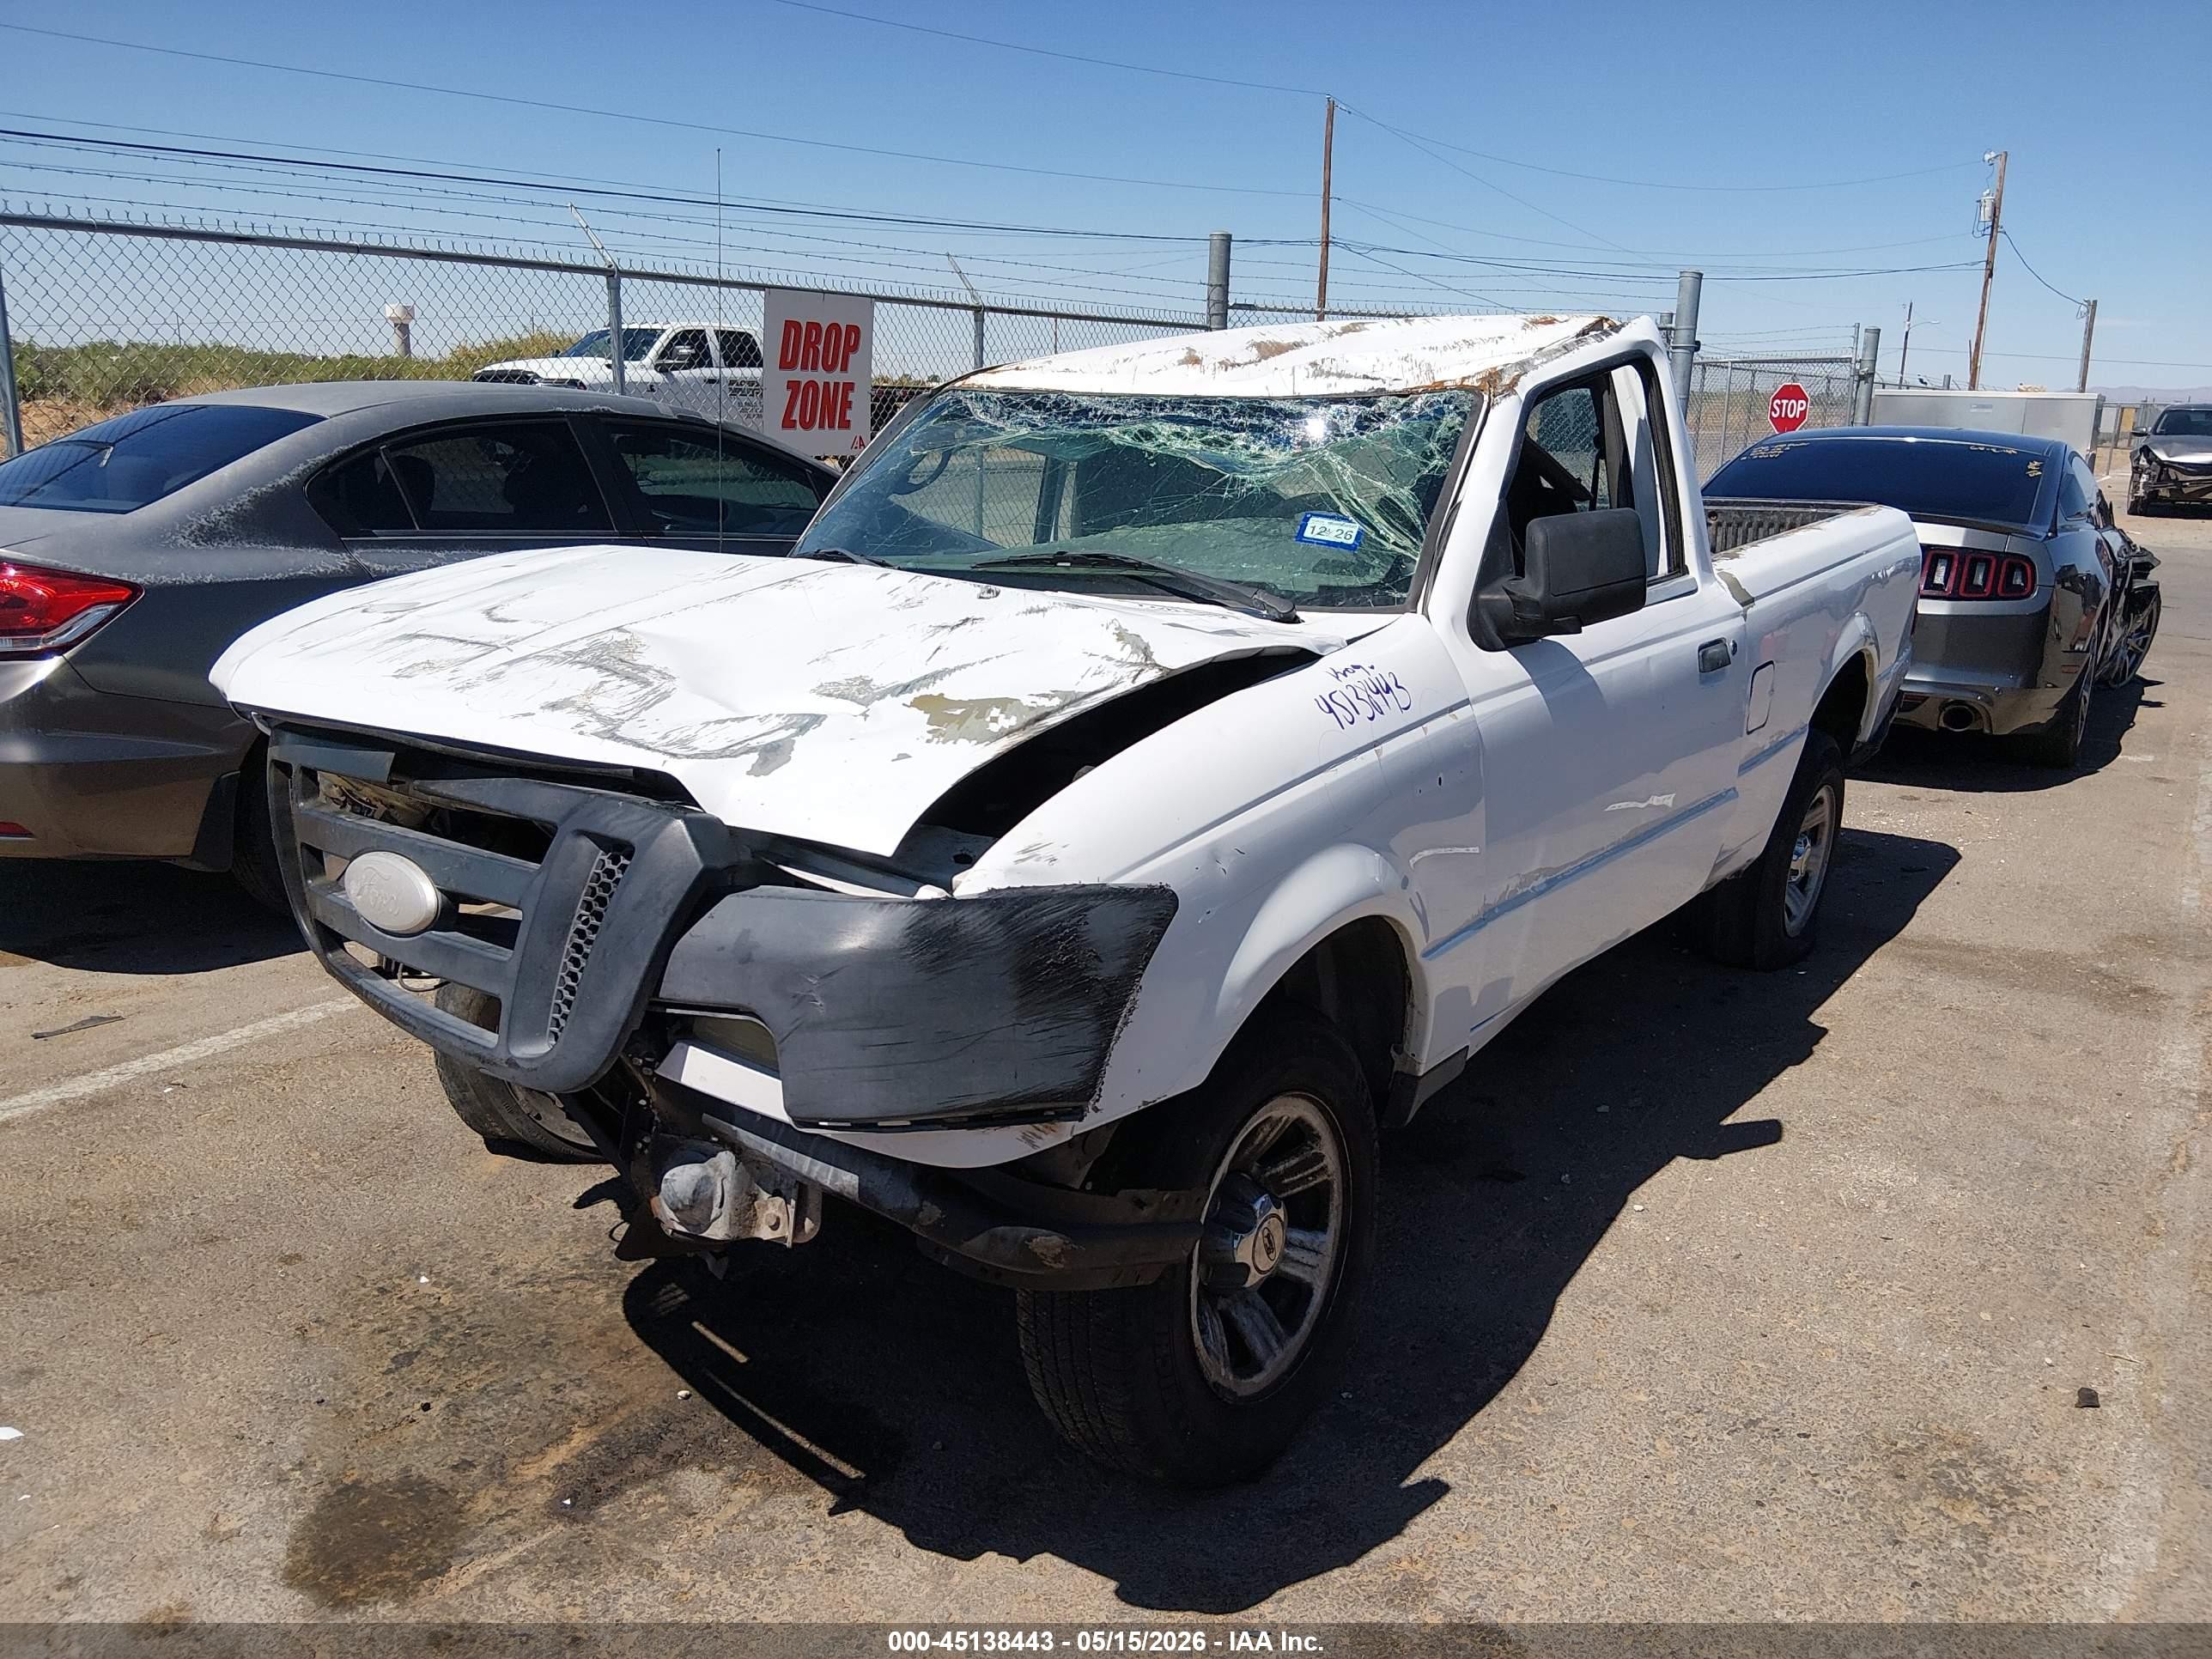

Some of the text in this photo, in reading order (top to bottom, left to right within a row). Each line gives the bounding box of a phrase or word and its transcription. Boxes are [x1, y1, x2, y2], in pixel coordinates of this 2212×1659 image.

[779, 319, 860, 373] DROP
[781, 380, 854, 430] ZONE
[1771, 399, 1806, 418] STOP
[1310, 525, 1354, 540] 12 26
[1314, 672, 1411, 730] 45138443
[356, 866, 401, 917] Ford
